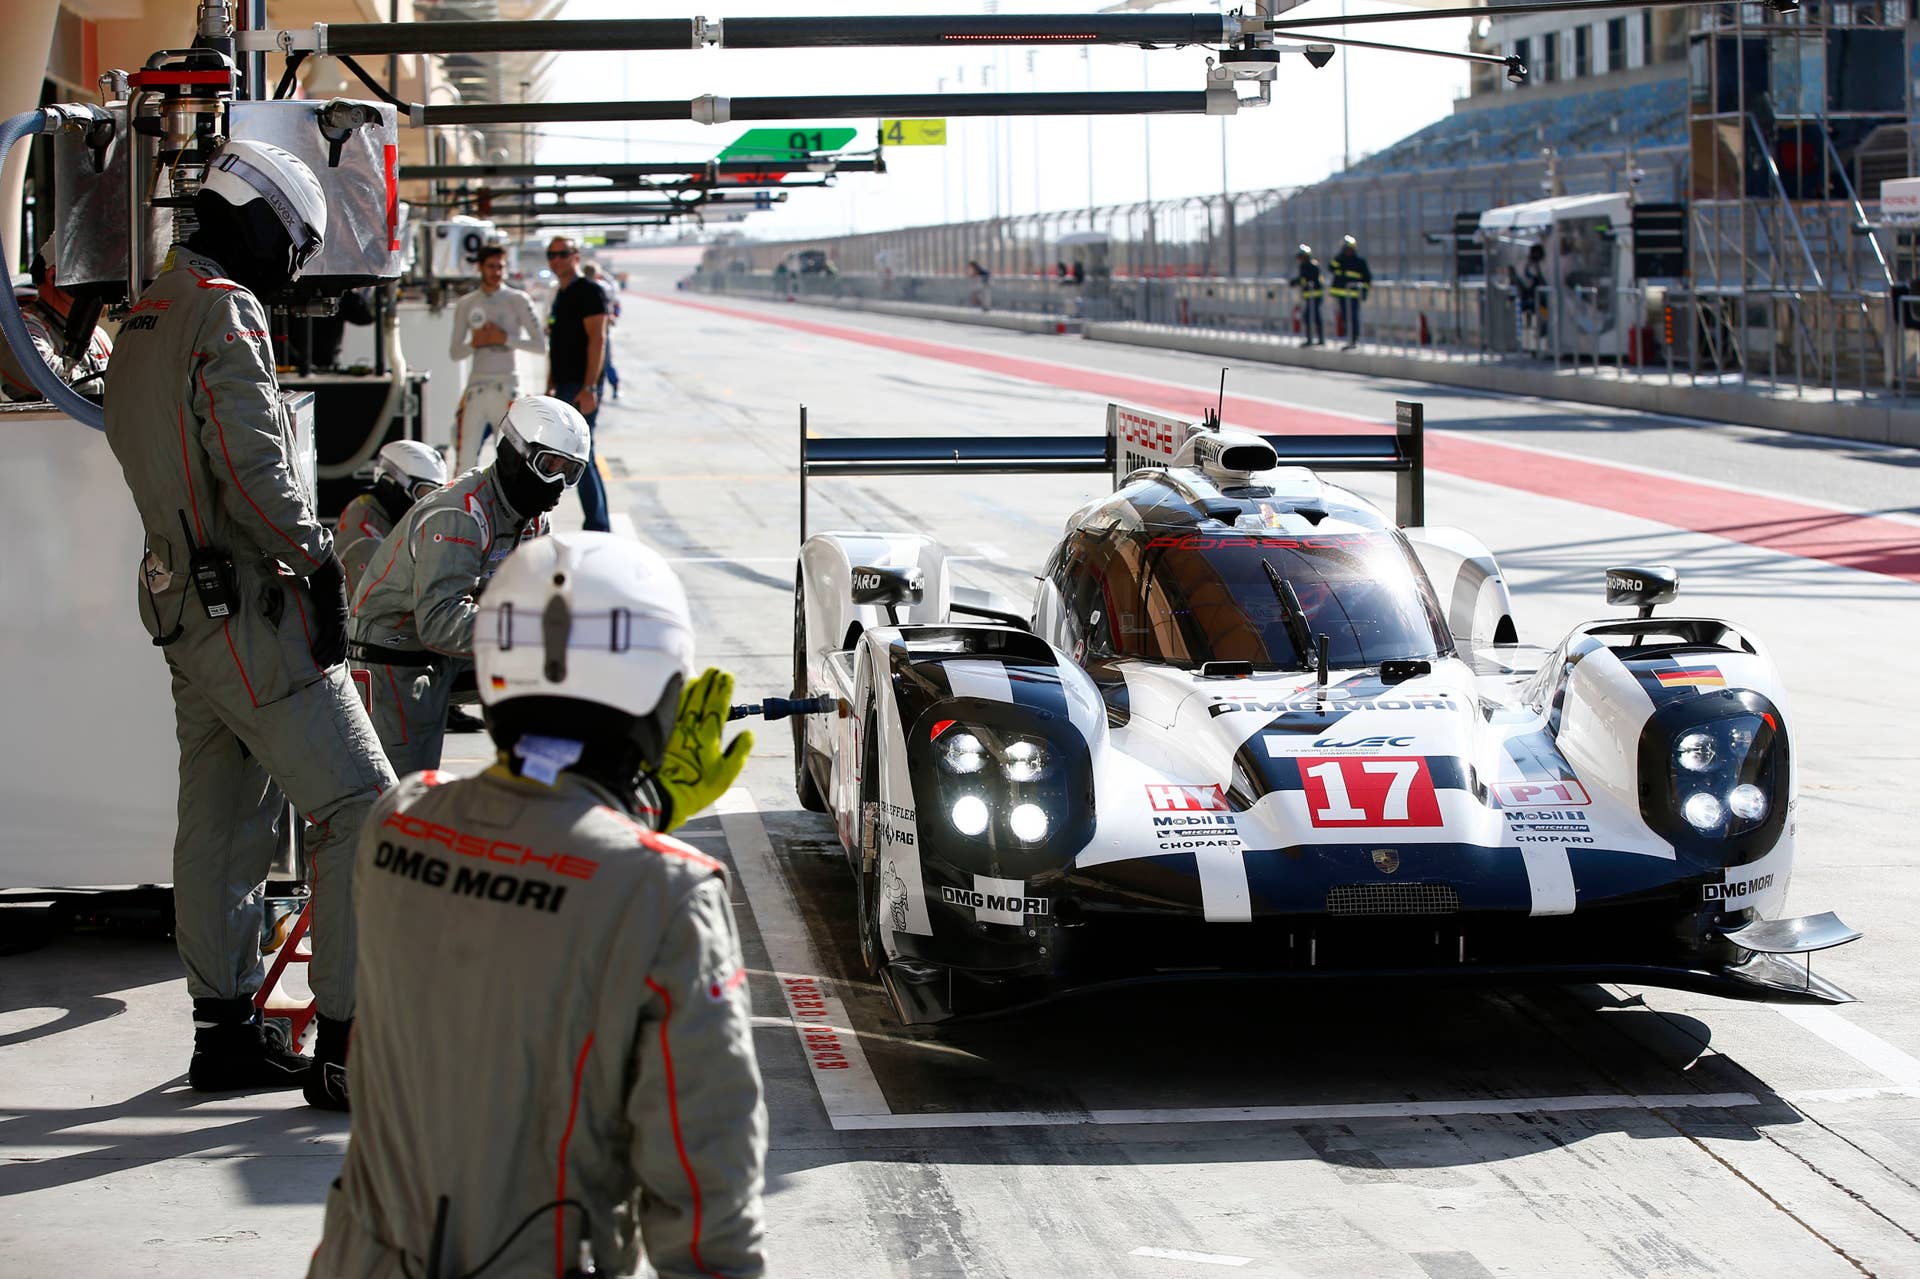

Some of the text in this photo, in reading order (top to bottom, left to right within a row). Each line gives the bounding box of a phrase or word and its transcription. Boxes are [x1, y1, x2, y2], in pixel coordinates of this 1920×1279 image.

[887, 121, 904, 144] 4
[1119, 411, 1173, 455] PORSCHE
[1208, 700, 1459, 719] DMG MORI
[1312, 736, 1416, 748] WEC
[1307, 761, 1420, 821] 17
[1509, 784, 1573, 802] P1
[1152, 816, 1213, 826] Mobil
[1505, 811, 1564, 821] Mobil
[895, 829, 914, 846] FAG
[1181, 828, 1236, 837] MICHELIN
[1515, 835, 1594, 843] CHOPARD
[383, 811, 600, 881] PORSCHE
[1159, 839, 1241, 850] CHOPARD
[373, 840, 567, 914] DMG MORI
[1703, 873, 1774, 901] DMG MORI
[942, 887, 1048, 915] DMG MORI
